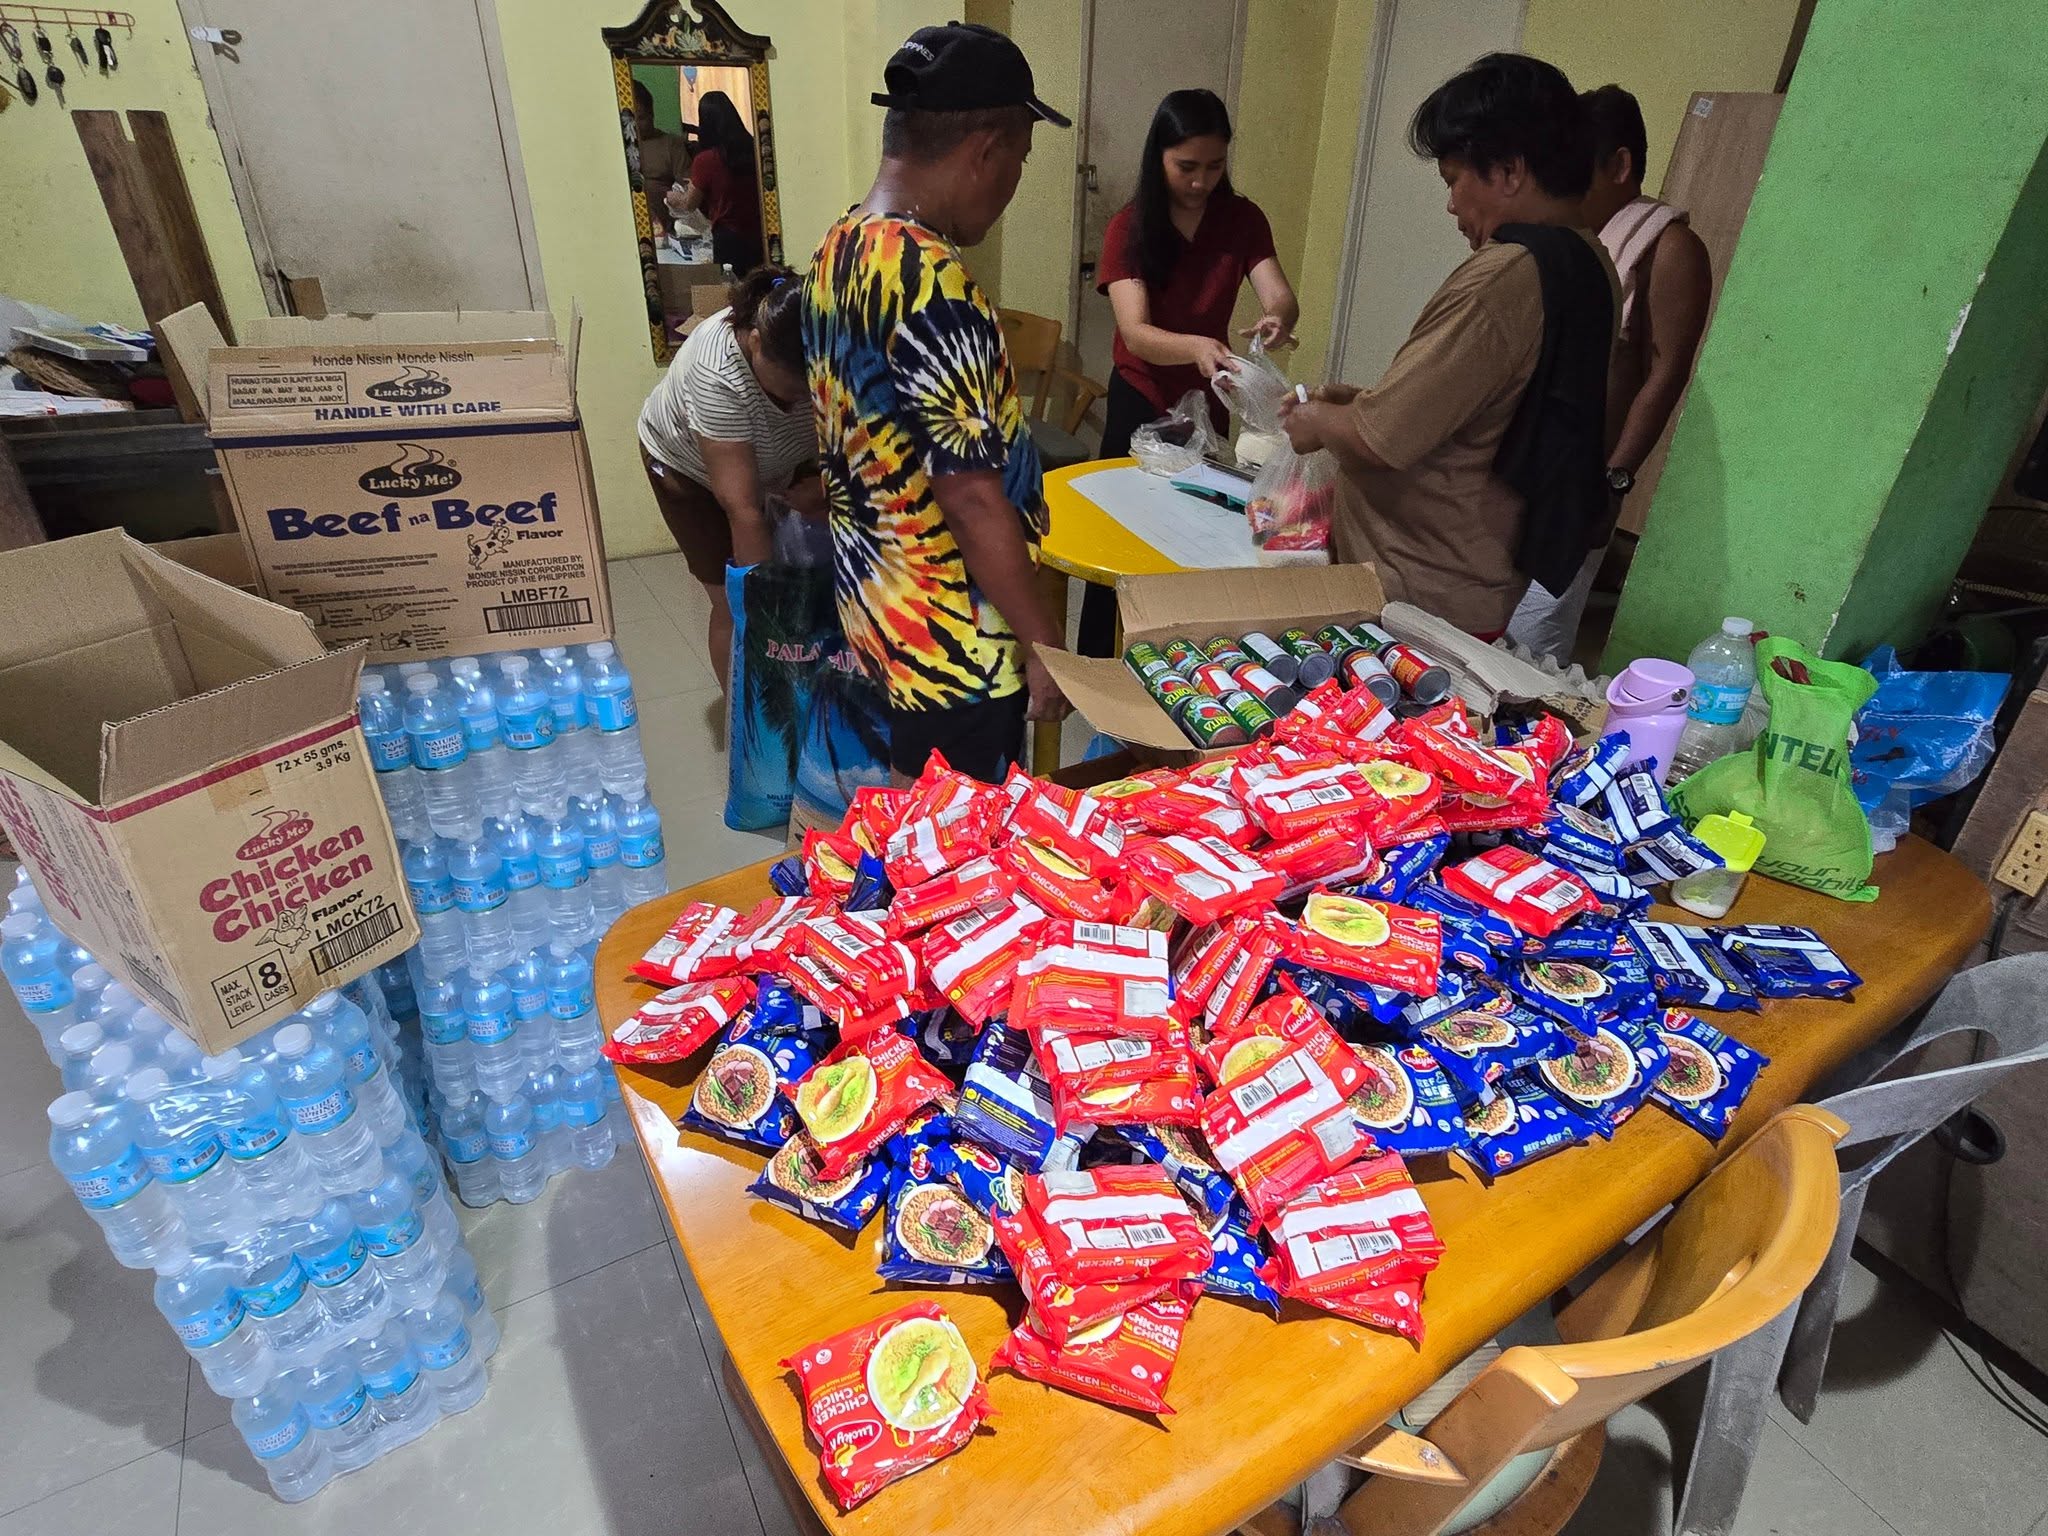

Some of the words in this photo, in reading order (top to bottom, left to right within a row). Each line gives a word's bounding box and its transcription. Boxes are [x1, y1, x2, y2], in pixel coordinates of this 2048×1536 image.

[313, 355, 353, 367] Monde
[357, 353, 393, 365] Nissin
[397, 352, 436, 364] Monde
[440, 351, 474, 363] Nissin
[374, 386, 417, 398] Lucky
[420, 386, 445, 396] Me!
[315, 406, 392, 421] HANDLE
[398, 403, 447, 417] WITH
[452, 401, 501, 414] CARE
[244, 449, 264, 460] EXP
[368, 477, 421, 489] Lucky
[424, 474, 453, 486] Me!
[267, 503, 401, 541] Beef
[408, 512, 430, 526] na
[432, 492, 558, 530] Beef
[516, 529, 564, 540] Flavor
[502, 556, 569, 568] MANUFACTURED
[571, 555, 583, 563] BY:
[466, 578, 506, 589] PRODUCT
[508, 577, 519, 585] OF
[520, 575, 537, 584] THE
[538, 571, 586, 582] PHILIPPINES
[468, 570, 498, 580] MONDE
[499, 568, 526, 577] NISSIN
[527, 564, 585, 575] CORPORATION
[501, 586, 569, 604] LMBF72
[276, 760, 292, 773] 72
[294, 759, 302, 767] x
[303, 750, 318, 762] 55
[321, 740, 347, 760] gms.
[316, 759, 332, 772] 3.9
[335, 751, 351, 765] Kg
[242, 832, 284, 857] Lucky
[286, 822, 309, 839] Me!
[200, 825, 365, 912] Chicken
[285, 877, 299, 889] na
[1031, 872, 1066, 899] CHICKEN
[213, 854, 373, 942] Chicken
[311, 889, 364, 922] Flavor
[315, 895, 384, 942] LMCK72
[931, 902, 971, 920] CHICKEN
[1333, 957, 1376, 974] CHICKEN
[258, 962, 282, 989] 8
[219, 980, 242, 996] MAX.
[264, 984, 290, 1002] CASES
[226, 988, 253, 1007] STACK
[230, 1001, 255, 1018] LEVEL
[1077, 1256, 1125, 1269] CHICKEN
[1216, 1275, 1240, 1289] BEEF
[1309, 1277, 1356, 1294] CHICKEN
[1126, 1313, 1179, 1339] CHICKEN
[1133, 1326, 1178, 1351] CHICKE
[1051, 1366, 1100, 1386] CHICKEN
[1111, 1384, 1161, 1409] CHICKEN
